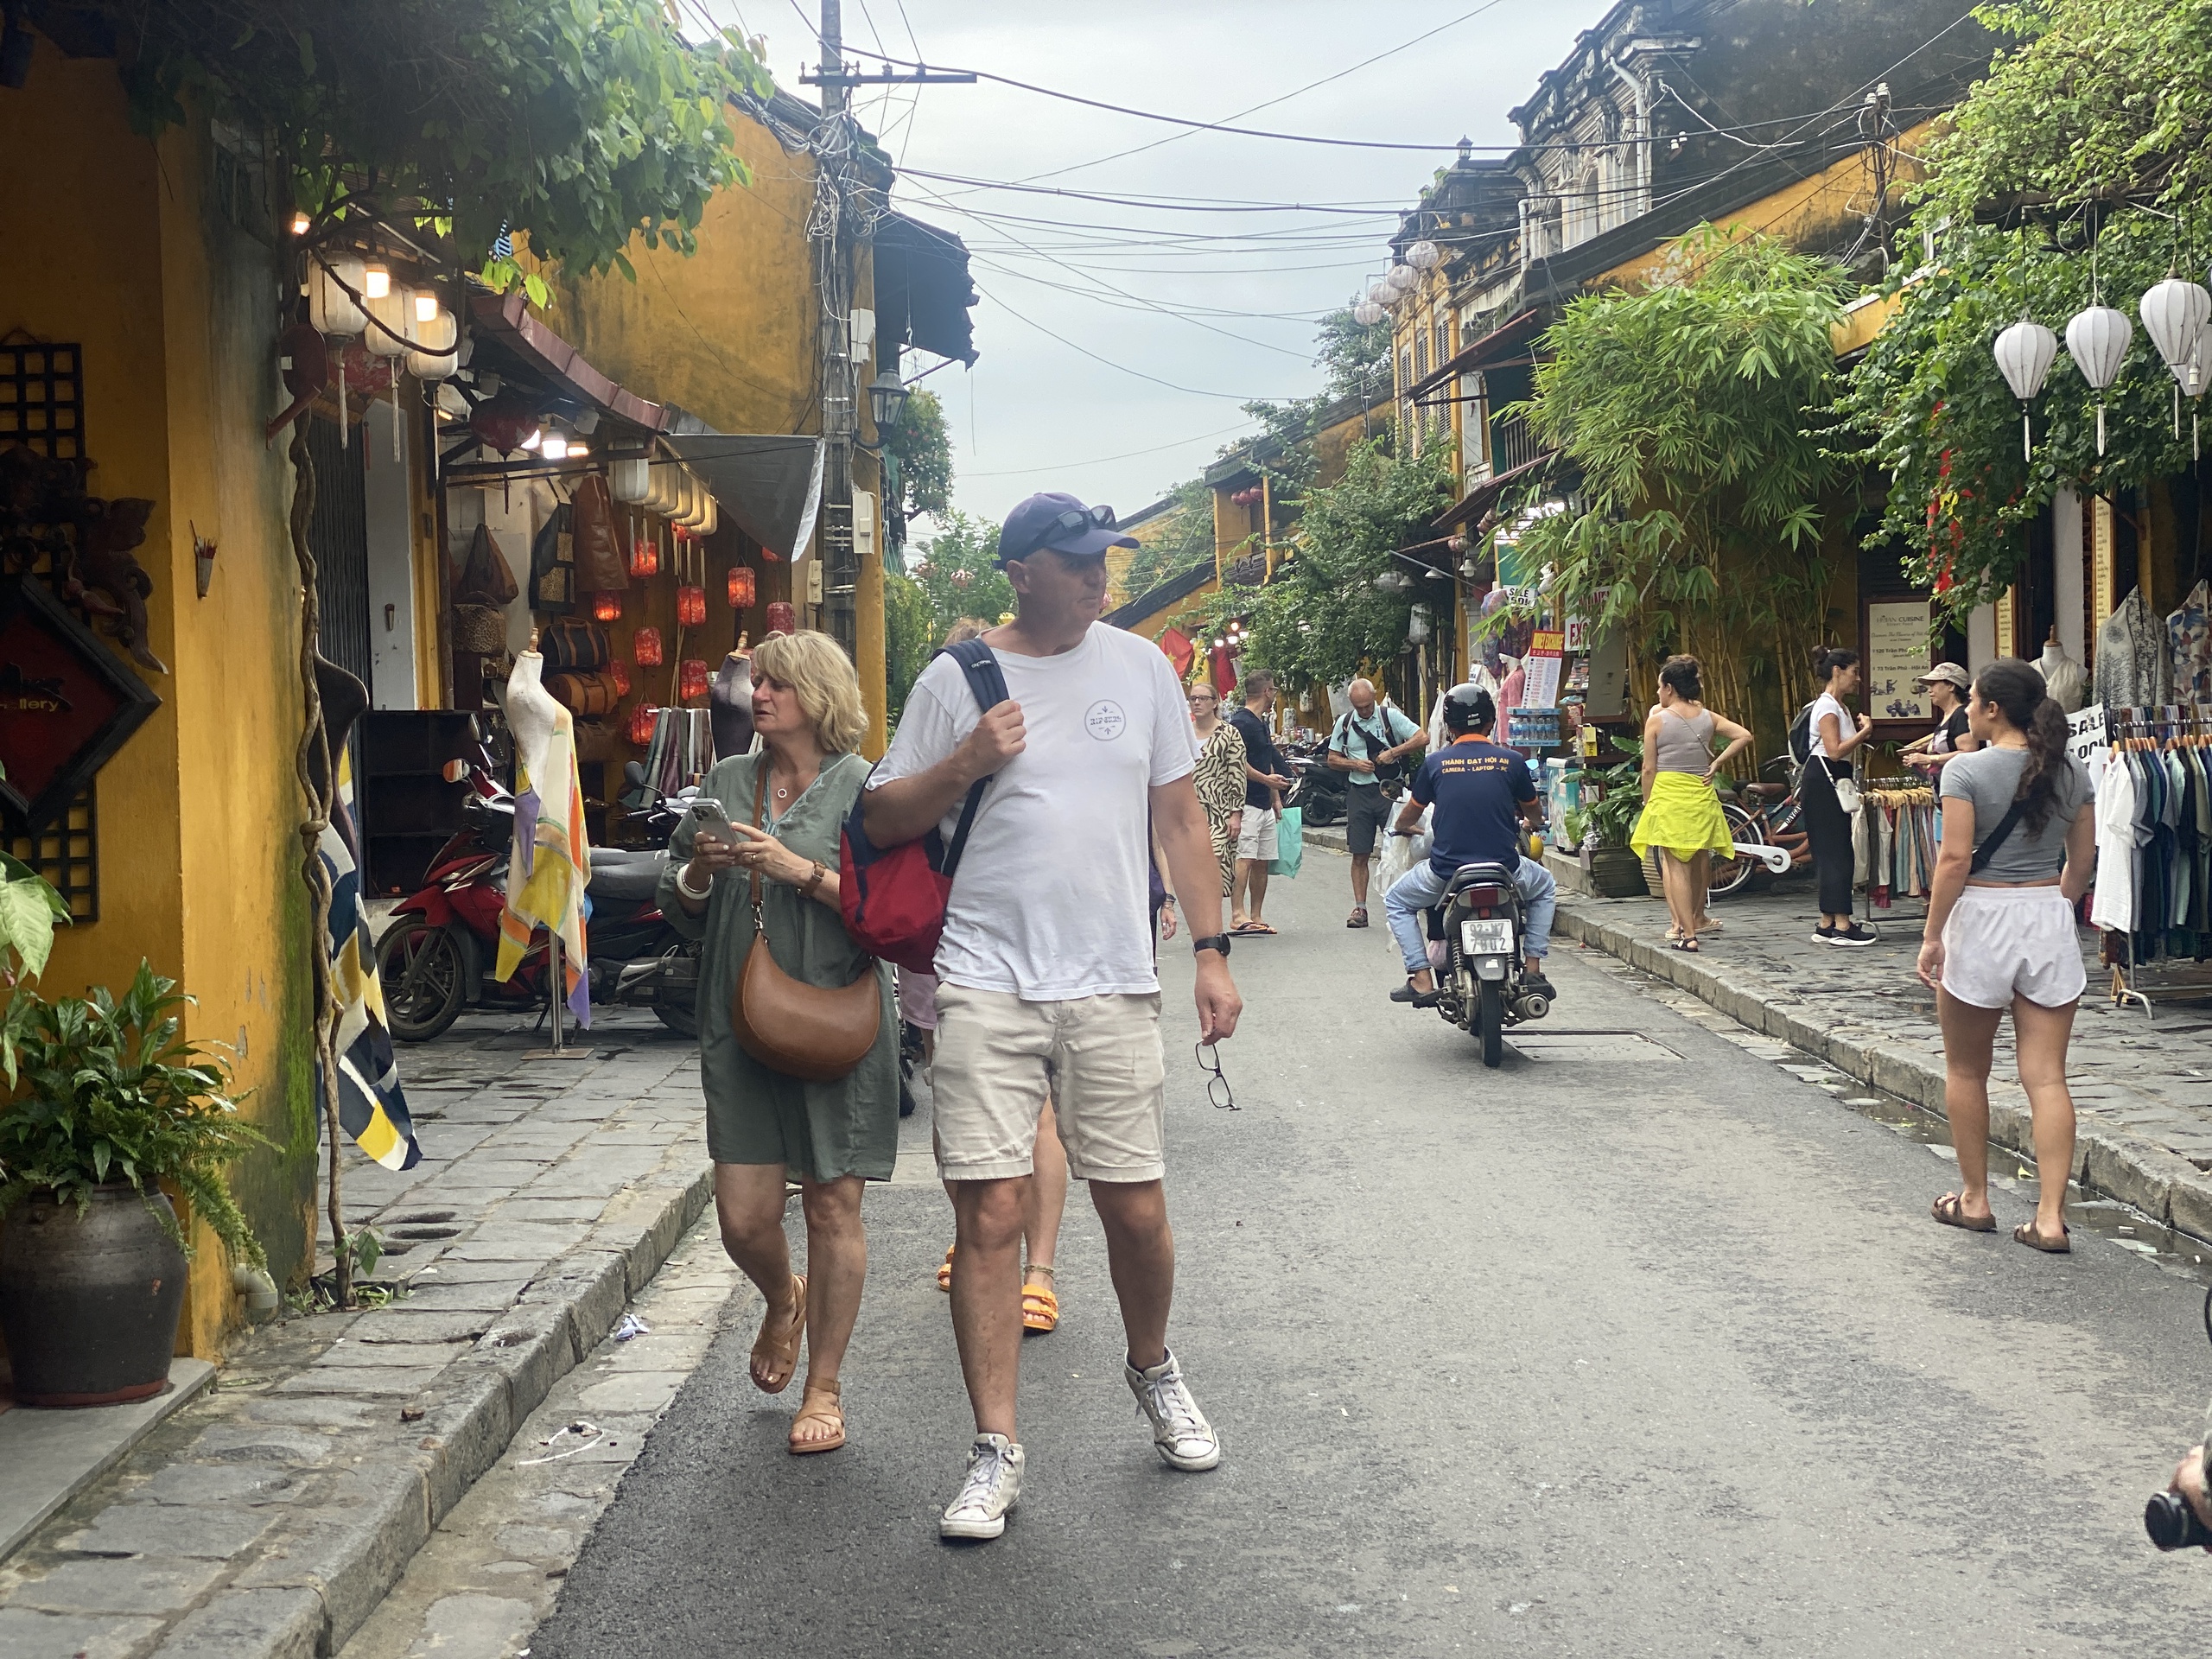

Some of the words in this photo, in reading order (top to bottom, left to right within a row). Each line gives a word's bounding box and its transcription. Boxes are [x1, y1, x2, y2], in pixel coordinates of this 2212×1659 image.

[1509, 588, 1529, 598] SLE
[1090, 717, 1103, 726] RIP
[2067, 712, 2104, 738] SALE
